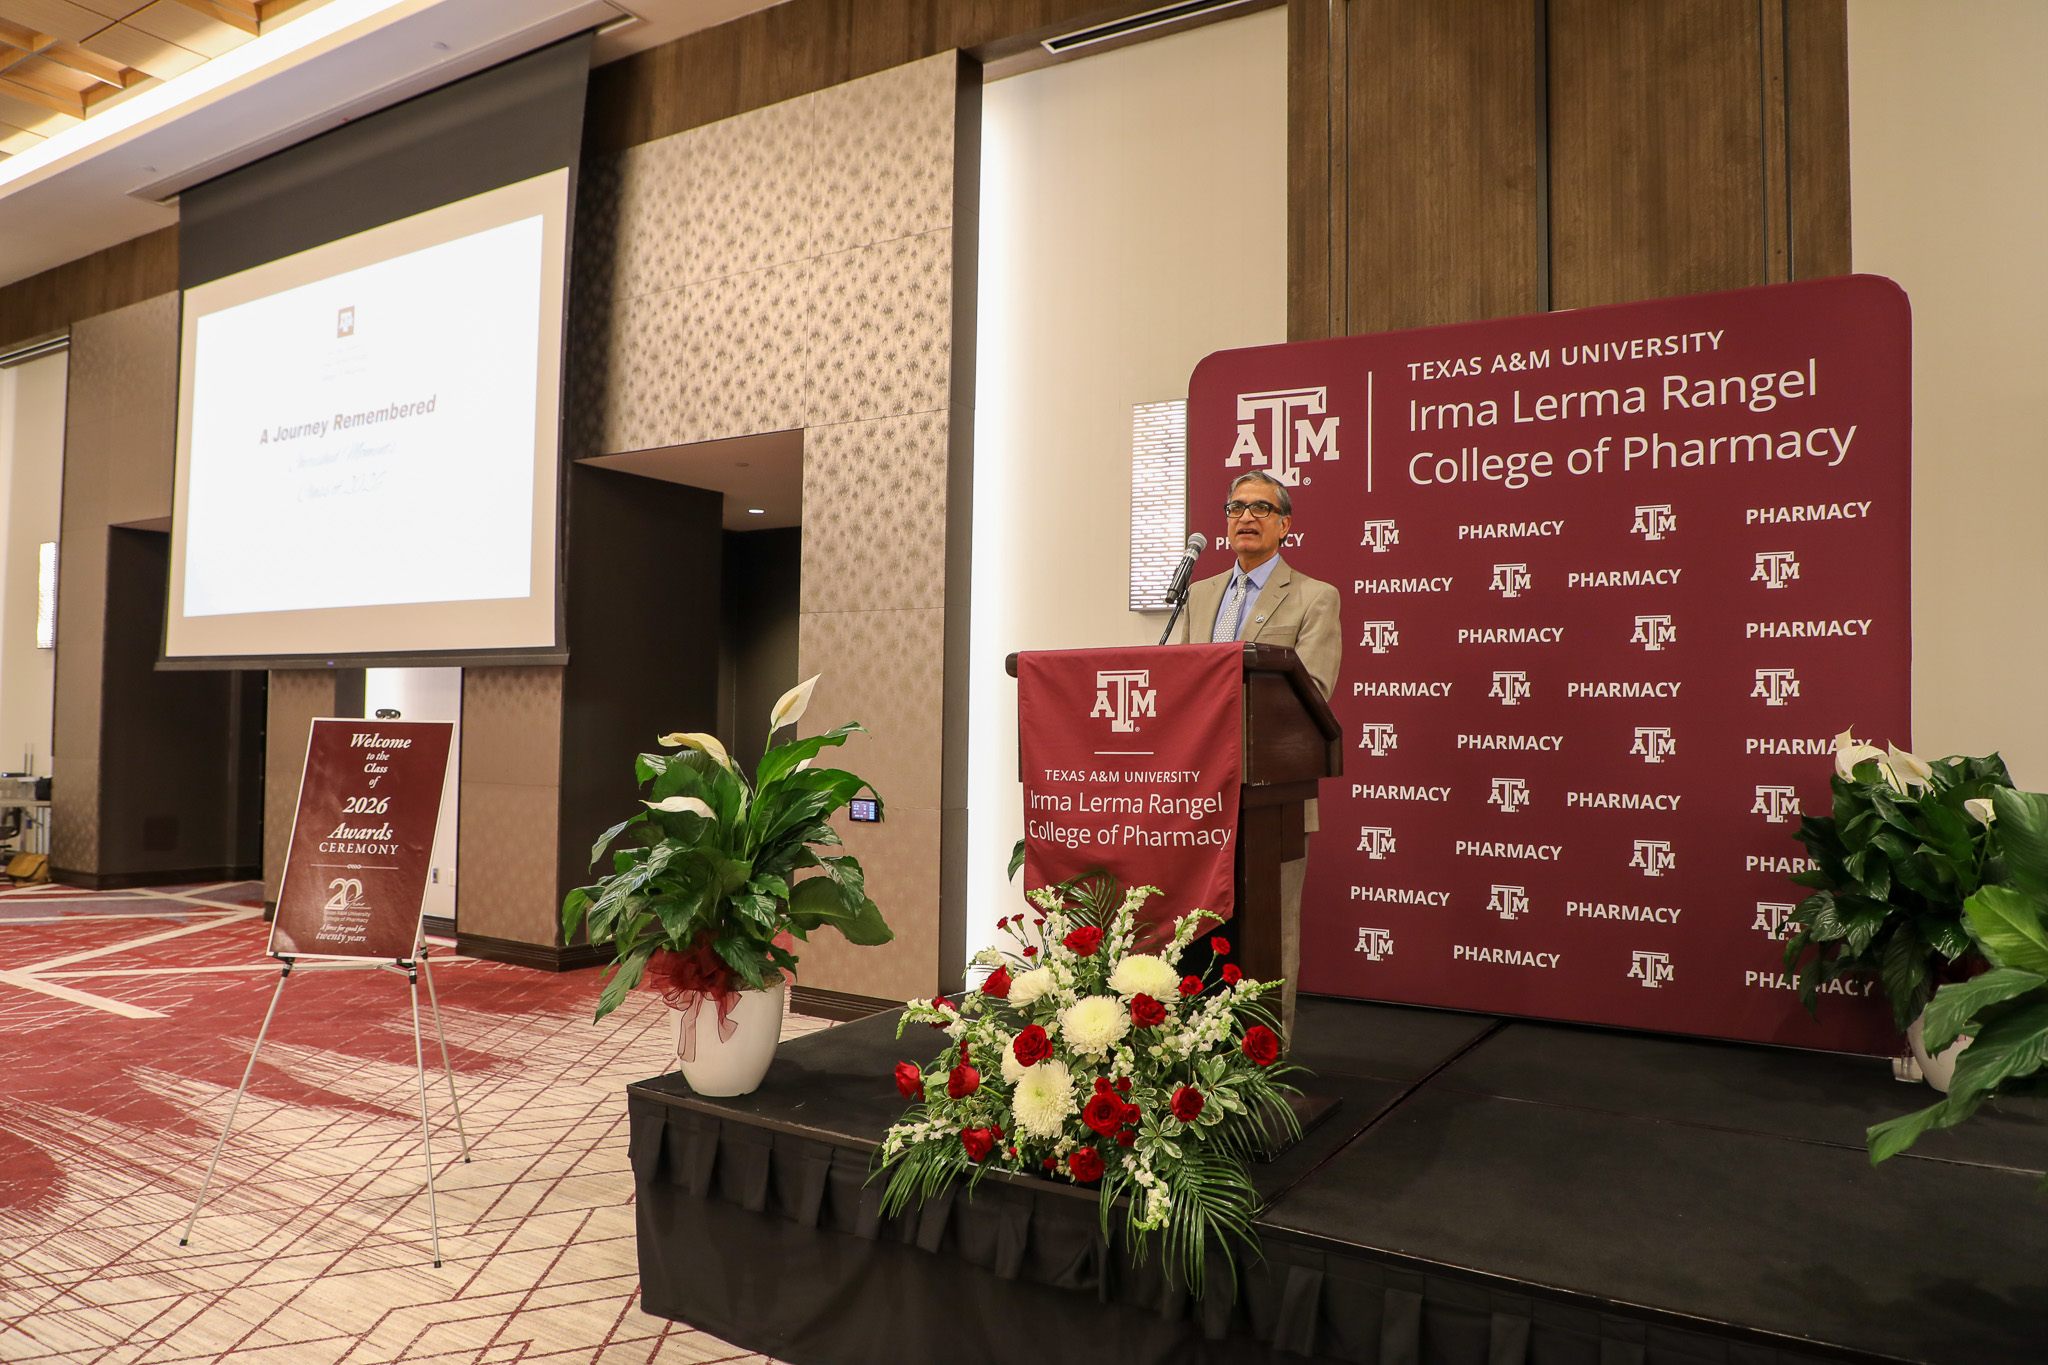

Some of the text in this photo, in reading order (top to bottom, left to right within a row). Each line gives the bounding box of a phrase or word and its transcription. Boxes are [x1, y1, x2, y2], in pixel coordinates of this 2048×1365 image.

[1407, 329, 1725, 382] TEXAS A&M UNIVERSITY
[1410, 357, 1816, 432] Irma Lerma Rangel
[259, 394, 437, 445] A Journey Remembered
[1408, 425, 1857, 490] College of Pharmacy
[1746, 500, 1872, 525] PHARMACY
[1458, 520, 1565, 540] PHARMACY
[1354, 576, 1453, 594] PHARMACY
[1568, 568, 1682, 588] PHARMACY
[1458, 627, 1565, 644] PHARMACY
[1746, 618, 1873, 639] PHARMACY
[1353, 682, 1453, 697] PHARMACY
[1567, 681, 1682, 698] PHARMACY
[350, 732, 412, 749] Welcome
[1457, 734, 1564, 751] PHARMACY
[376, 751, 389, 761] the
[364, 763, 388, 773] Class
[1044, 769, 1201, 783] TEXAS A&M UNIVERSITY
[369, 776, 381, 788] of
[1352, 783, 1452, 802] PHARMACY
[1567, 791, 1682, 811] PHARMACY
[341, 796, 391, 815] 2026
[1030, 789, 1223, 820] Irma Lerma Rangel
[326, 822, 394, 841] Awards
[1029, 819, 1232, 851] College of Pharmacy
[318, 841, 399, 855] CEREMONY
[1455, 840, 1563, 861] PHARMACY
[324, 878, 362, 910] 20
[1350, 885, 1451, 907] PHARMACY
[1566, 901, 1682, 924] PHARMACY
[316, 932, 366, 943] twenty years
[324, 924, 337, 932] force
[336, 924, 344, 932] for
[344, 925, 358, 933] good
[356, 925, 366, 933] for
[1453, 944, 1561, 969] PHARMACY
